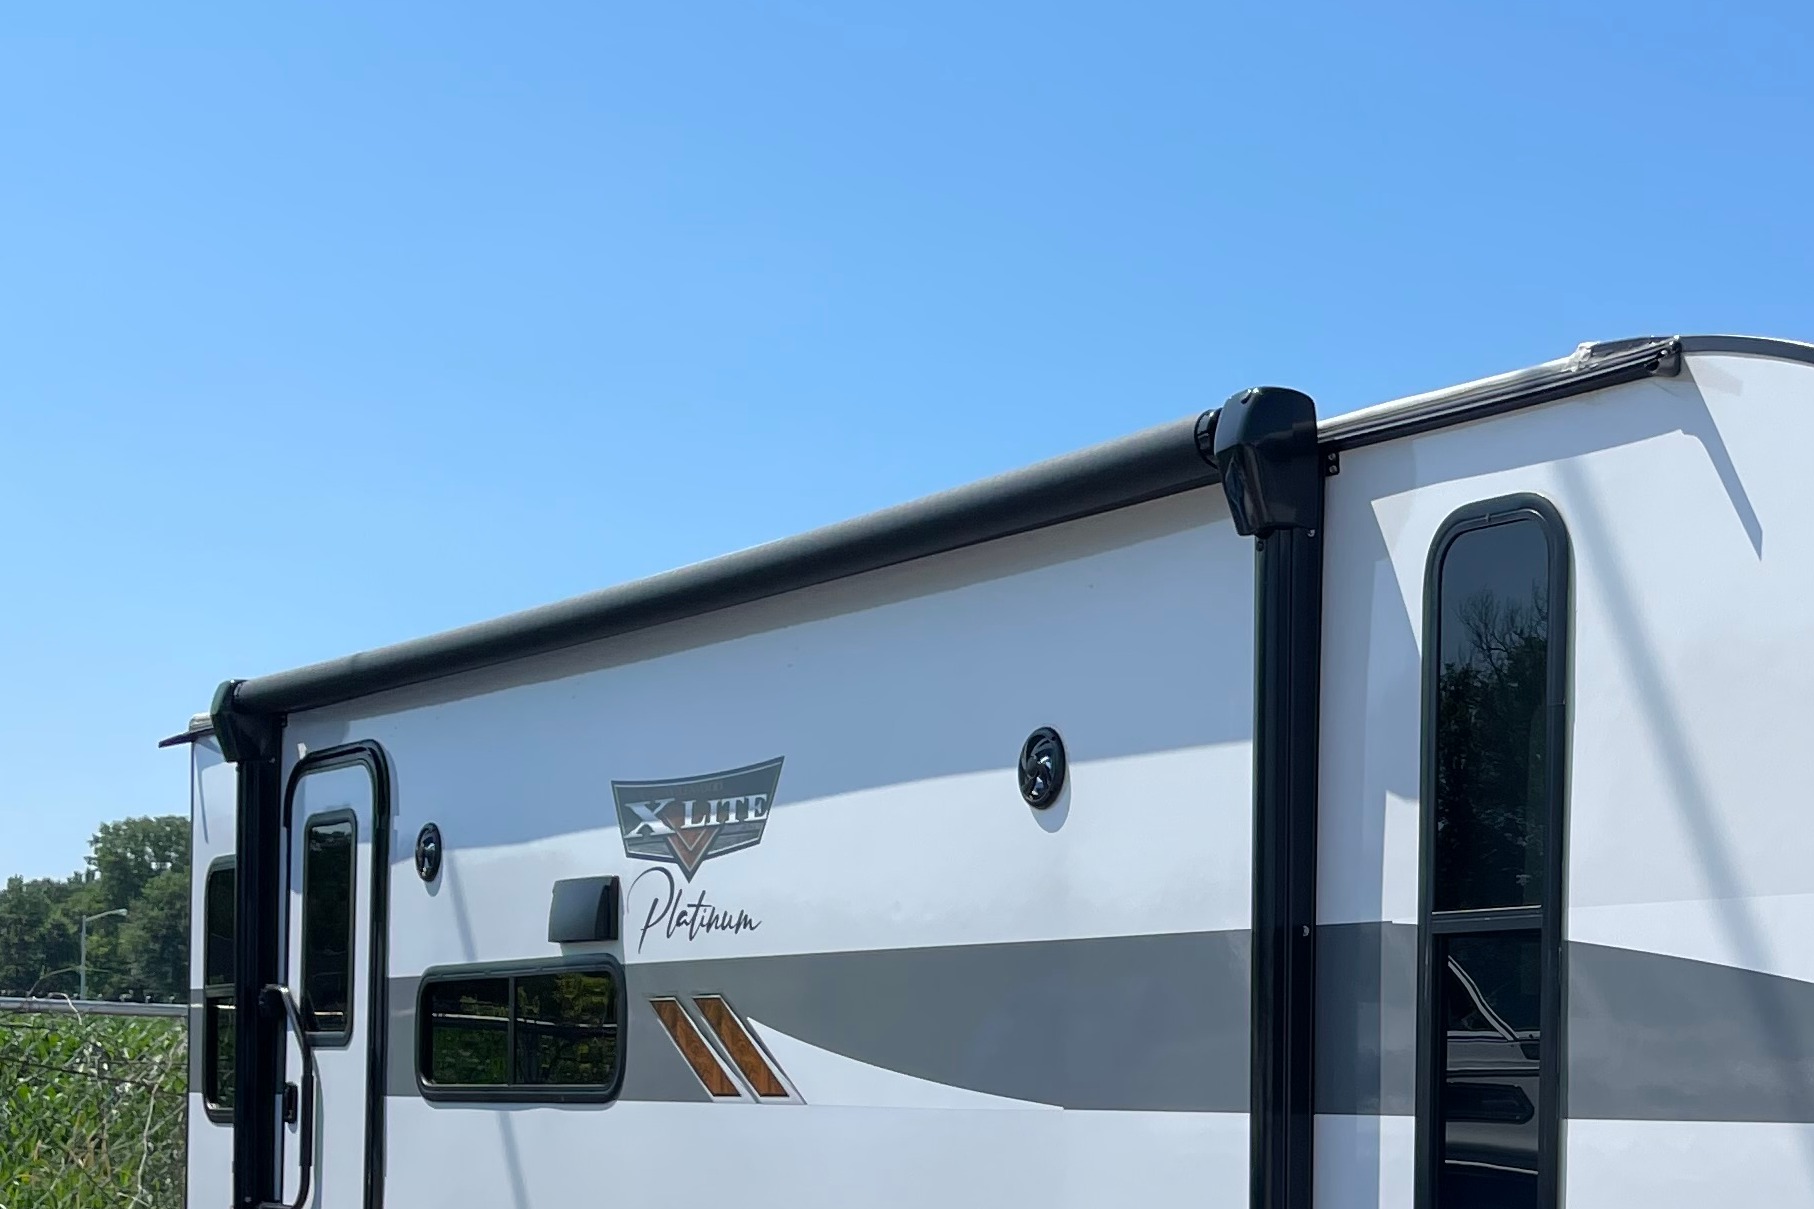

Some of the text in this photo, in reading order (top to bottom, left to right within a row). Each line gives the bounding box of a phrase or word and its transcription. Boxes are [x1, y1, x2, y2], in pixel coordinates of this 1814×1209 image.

[624, 794, 768, 839] X LITE
[626, 866, 762, 954] Platinum
